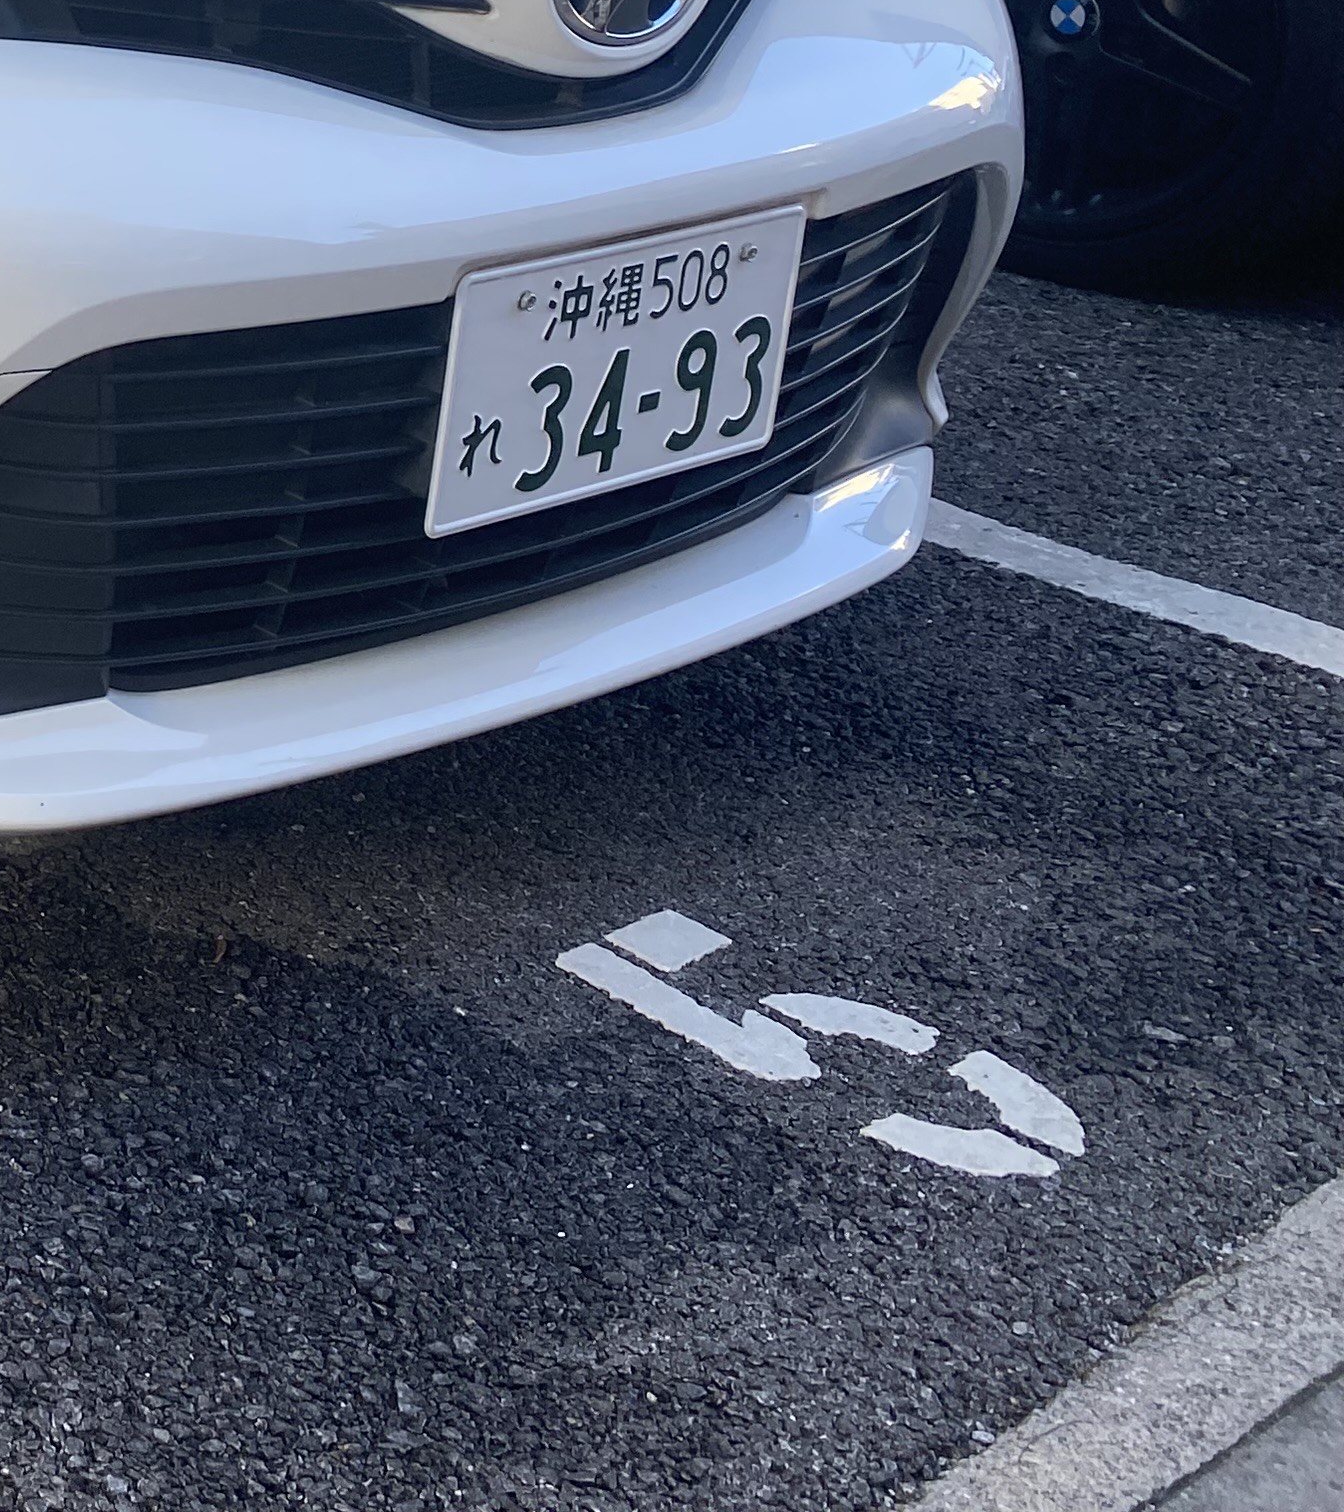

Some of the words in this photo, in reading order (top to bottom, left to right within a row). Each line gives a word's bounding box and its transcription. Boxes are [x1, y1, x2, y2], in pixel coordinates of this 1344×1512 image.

[458, 414, 503, 478] れ
[513, 315, 772, 493] 34-93
[554, 909, 1086, 1178] 5
